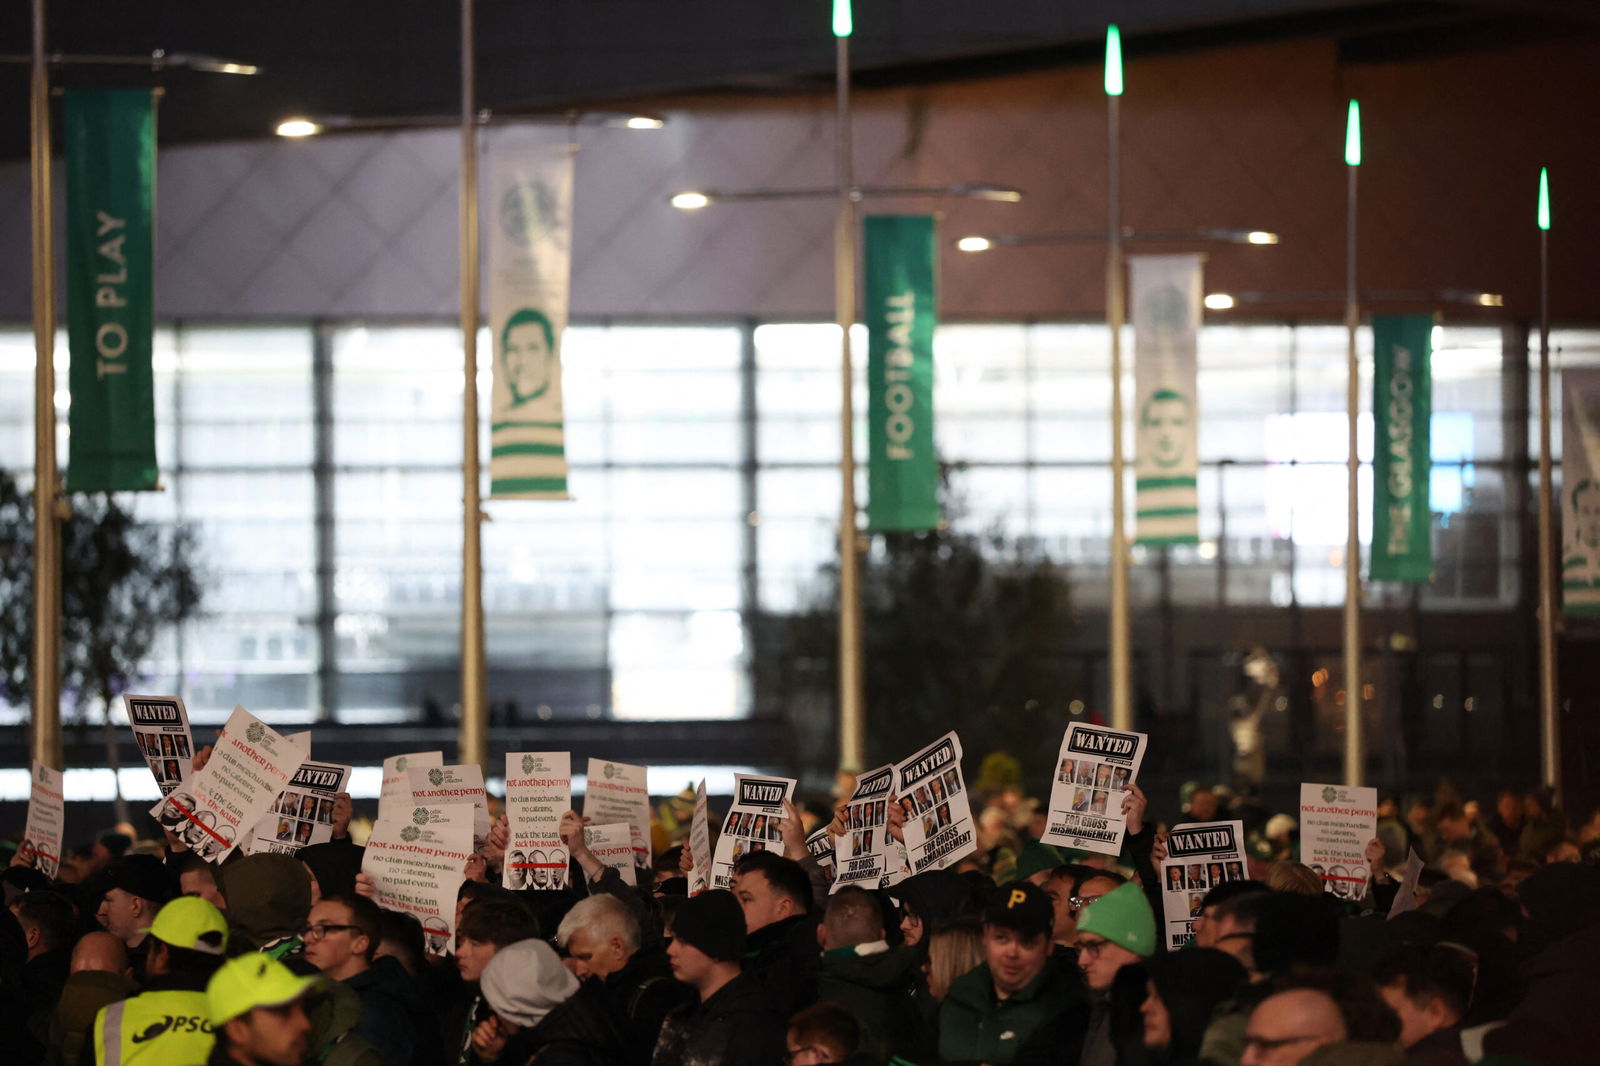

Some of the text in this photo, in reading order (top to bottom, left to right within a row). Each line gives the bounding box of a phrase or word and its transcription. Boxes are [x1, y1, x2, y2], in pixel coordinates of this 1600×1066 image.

[96, 211, 128, 381] TO PLAY
[885, 290, 915, 460] FOOTBALL
[1388, 343, 1413, 498] GLASGOW
[134, 704, 177, 721] WANTED
[1075, 732, 1133, 755] WANTED
[905, 746, 951, 784] WANTED
[294, 767, 338, 786] ANTED
[507, 778, 570, 789] not another penny
[412, 787, 485, 798] not another penny
[743, 784, 783, 802] WANTED
[1301, 805, 1315, 813] not
[1064, 814, 1108, 830] FOR GROSS
[529, 831, 541, 839] the
[923, 826, 959, 856] FOR GROSS
[1050, 822, 1118, 842] MISMANAGEMENT
[1171, 830, 1230, 851] WANTED
[369, 841, 468, 861] not another penny
[529, 839, 540, 848] the
[607, 846, 633, 857] penny
[914, 830, 971, 872] MISMANAGEMENT
[373, 855, 384, 863] no
[848, 858, 875, 871] FOR GROSS
[839, 867, 882, 882] MISMANAGEMENT
[398, 894, 412, 903] the
[1007, 889, 1027, 909] P
